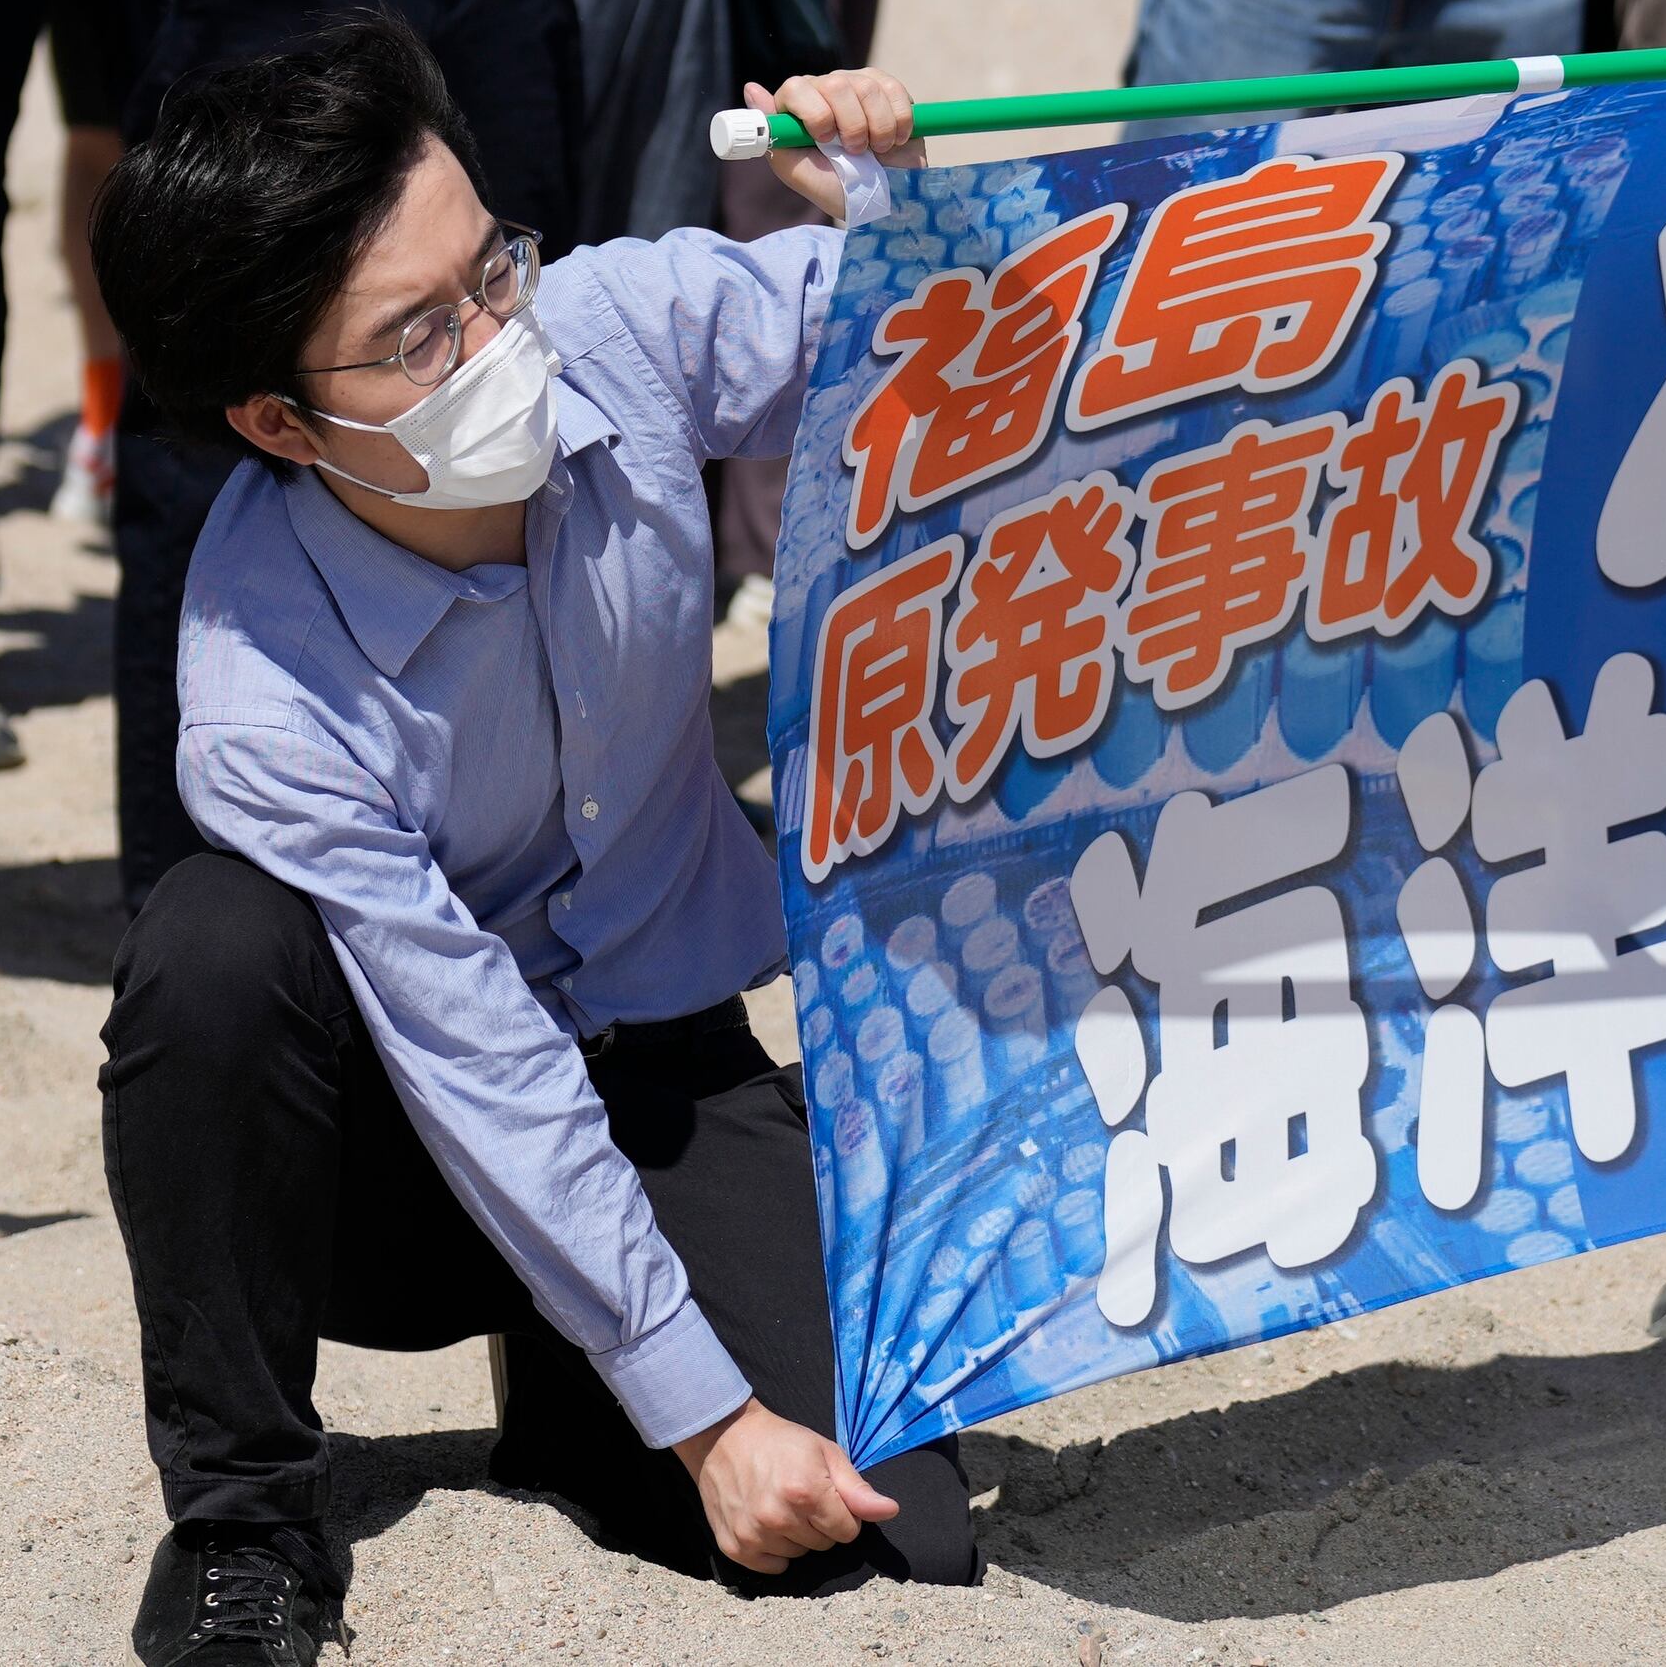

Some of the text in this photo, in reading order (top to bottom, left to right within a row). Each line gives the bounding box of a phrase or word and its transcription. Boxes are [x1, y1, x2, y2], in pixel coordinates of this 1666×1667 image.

[844, 153, 1403, 549] 福島
[803, 359, 1519, 884] 原発事故
